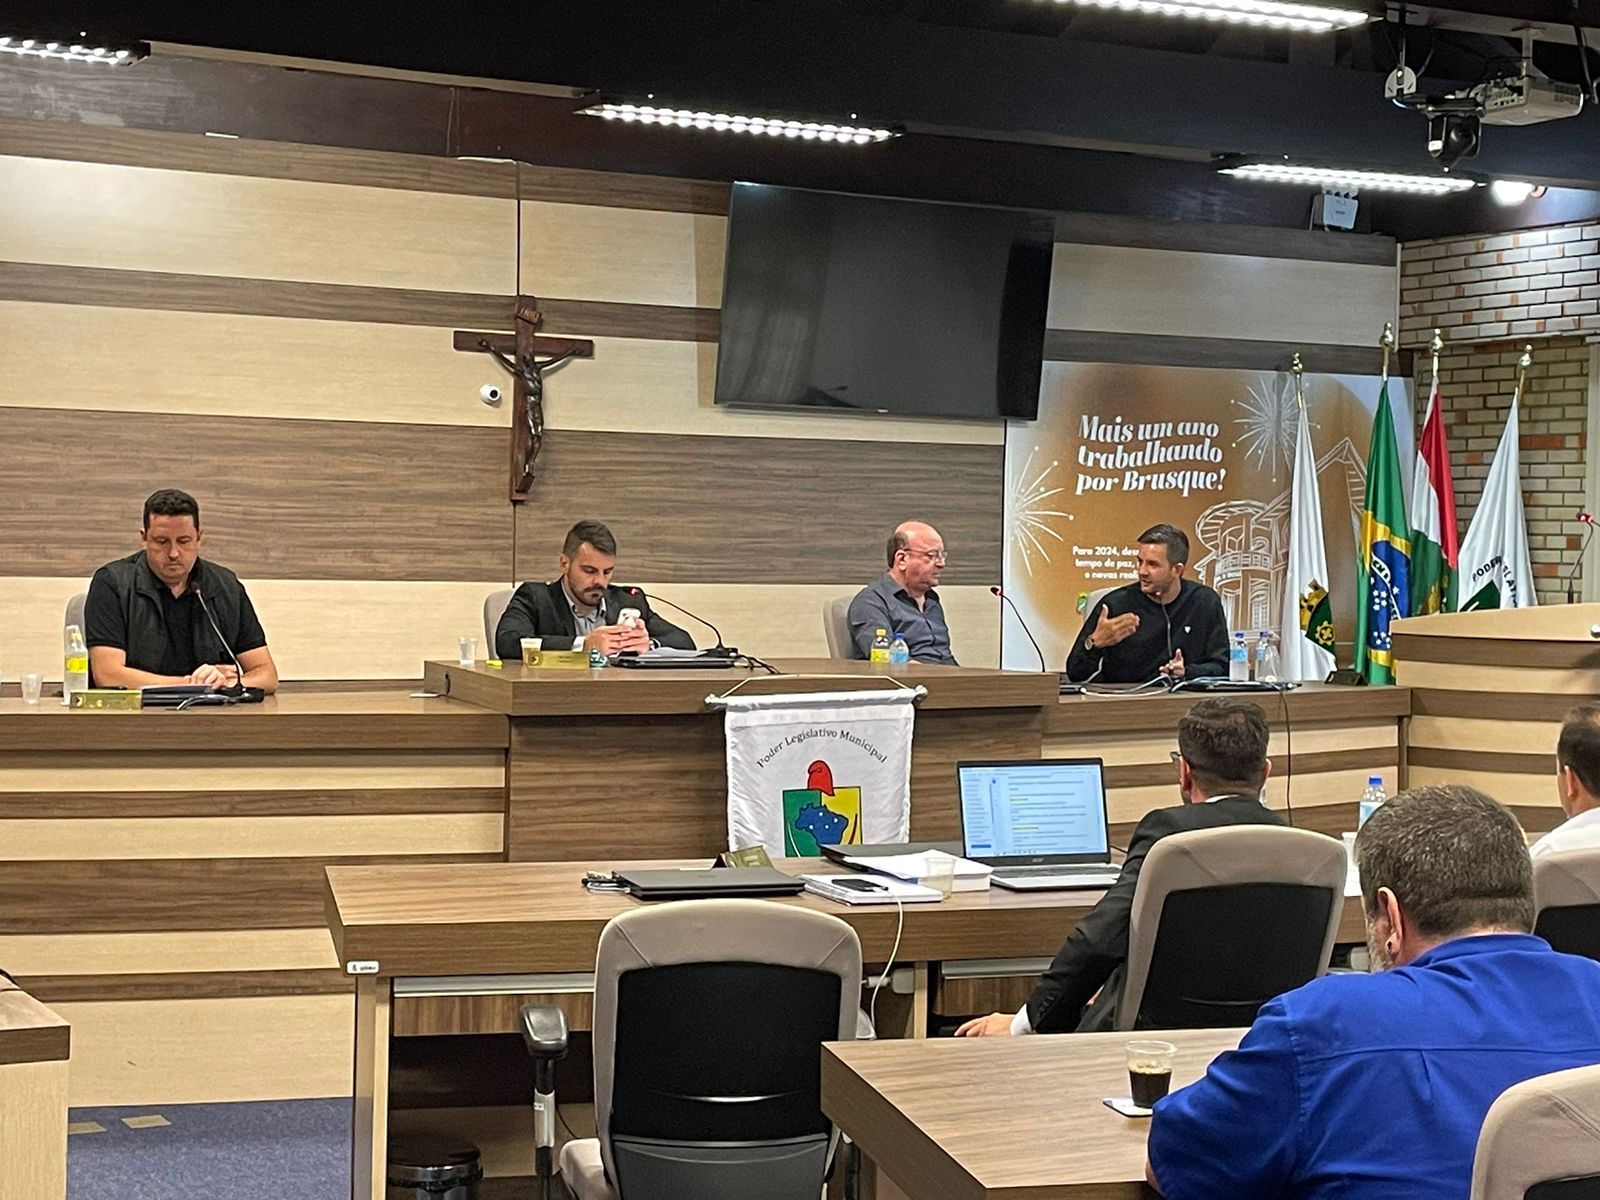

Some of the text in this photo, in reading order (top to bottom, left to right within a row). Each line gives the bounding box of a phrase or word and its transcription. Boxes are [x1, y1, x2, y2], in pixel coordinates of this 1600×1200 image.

[1078, 414, 1220, 443] Mais um ano
[1077, 438, 1223, 470] trabalhando
[1075, 468, 1227, 497] por Brusque!
[1072, 545, 1094, 556] Para
[1094, 545, 1120, 557] 2024,
[1075, 558, 1103, 570] tempo
[1104, 557, 1116, 568] de
[1091, 571, 1118, 580] novas
[756, 727, 888, 769] Poder Legislativo Municipal
